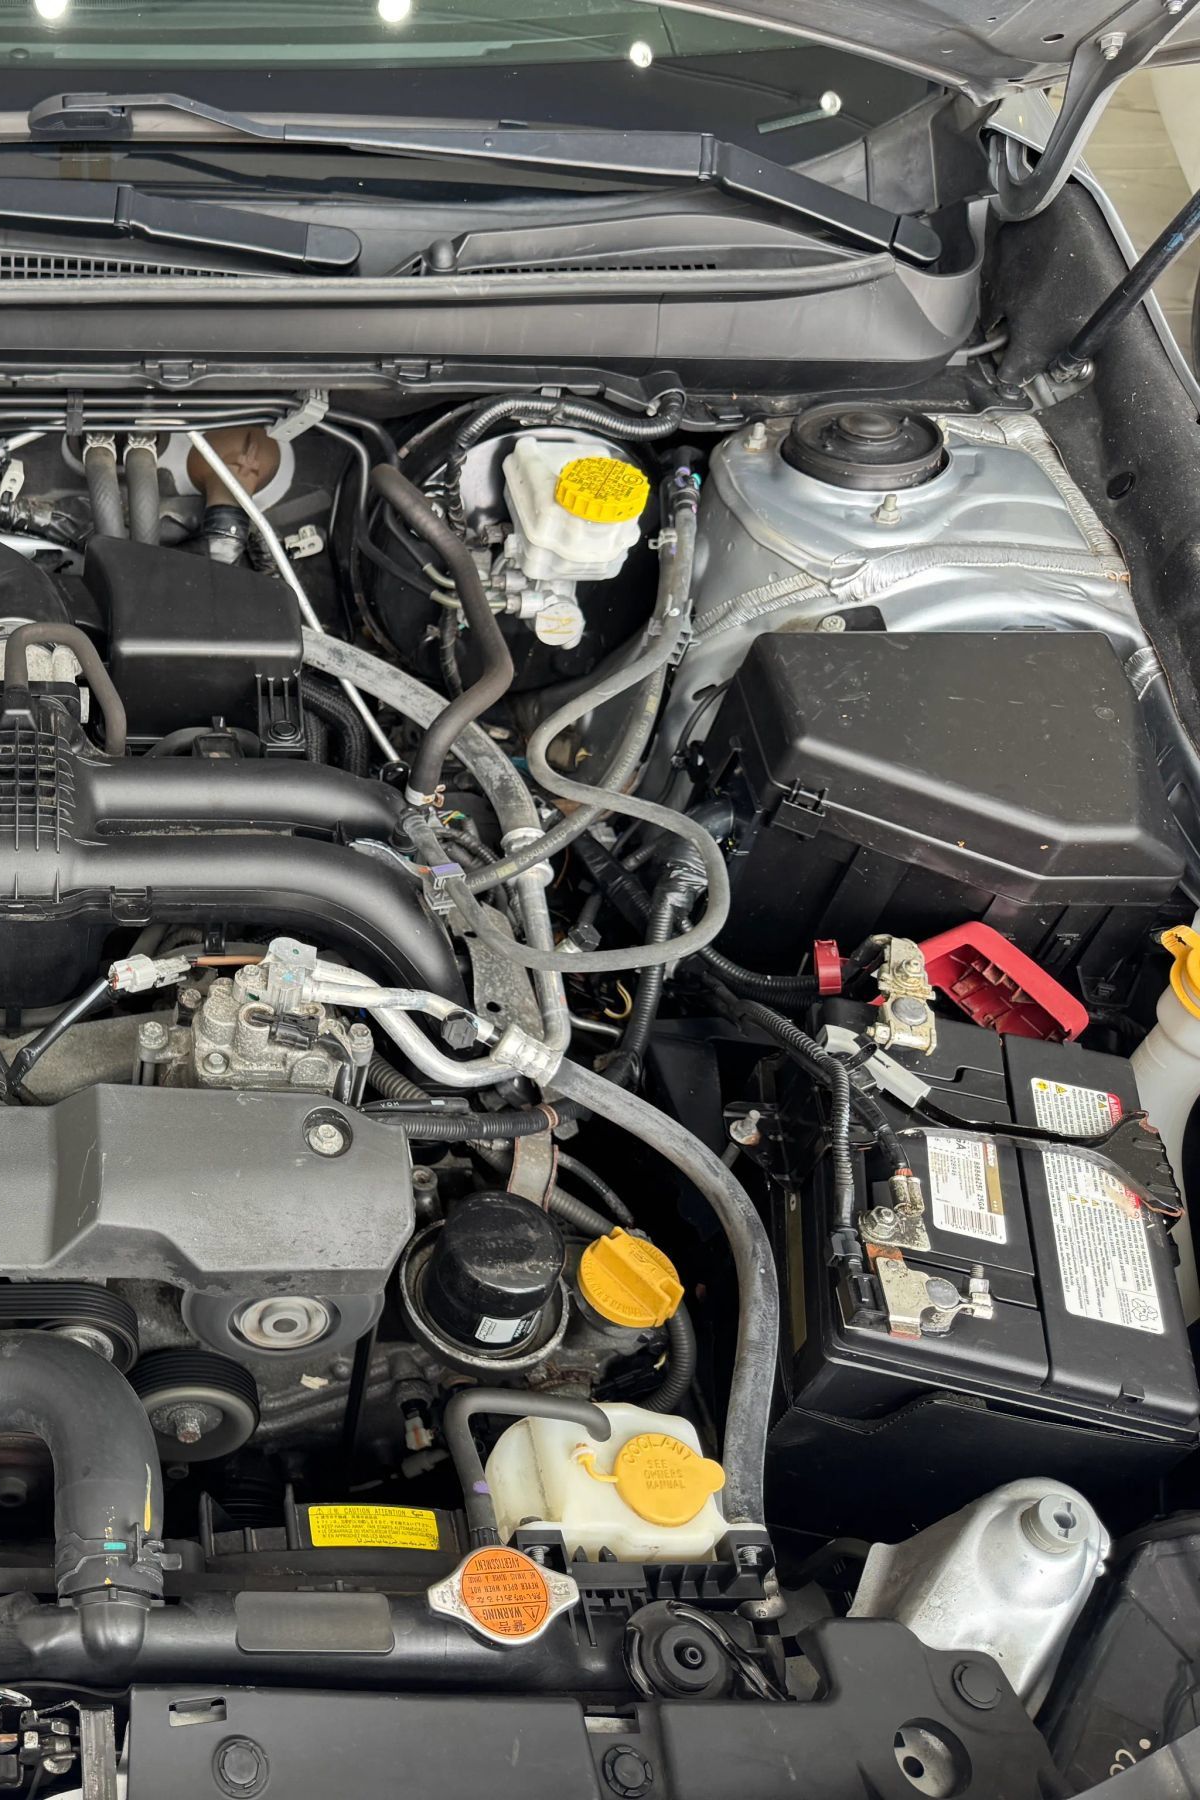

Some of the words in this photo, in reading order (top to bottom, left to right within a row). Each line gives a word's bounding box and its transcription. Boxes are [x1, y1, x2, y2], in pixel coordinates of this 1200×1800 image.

[621, 1435, 692, 1464] COOLANT
[646, 1459, 669, 1469] SEE
[646, 1480, 686, 1490] MANUAL
[343, 1507, 370, 1515] CAUTION
[374, 1508, 406, 1516] ATTENTION
[502, 1583, 519, 1592] OPEN
[521, 1582, 540, 1590] NEVER
[482, 1606, 523, 1621] WARNING
